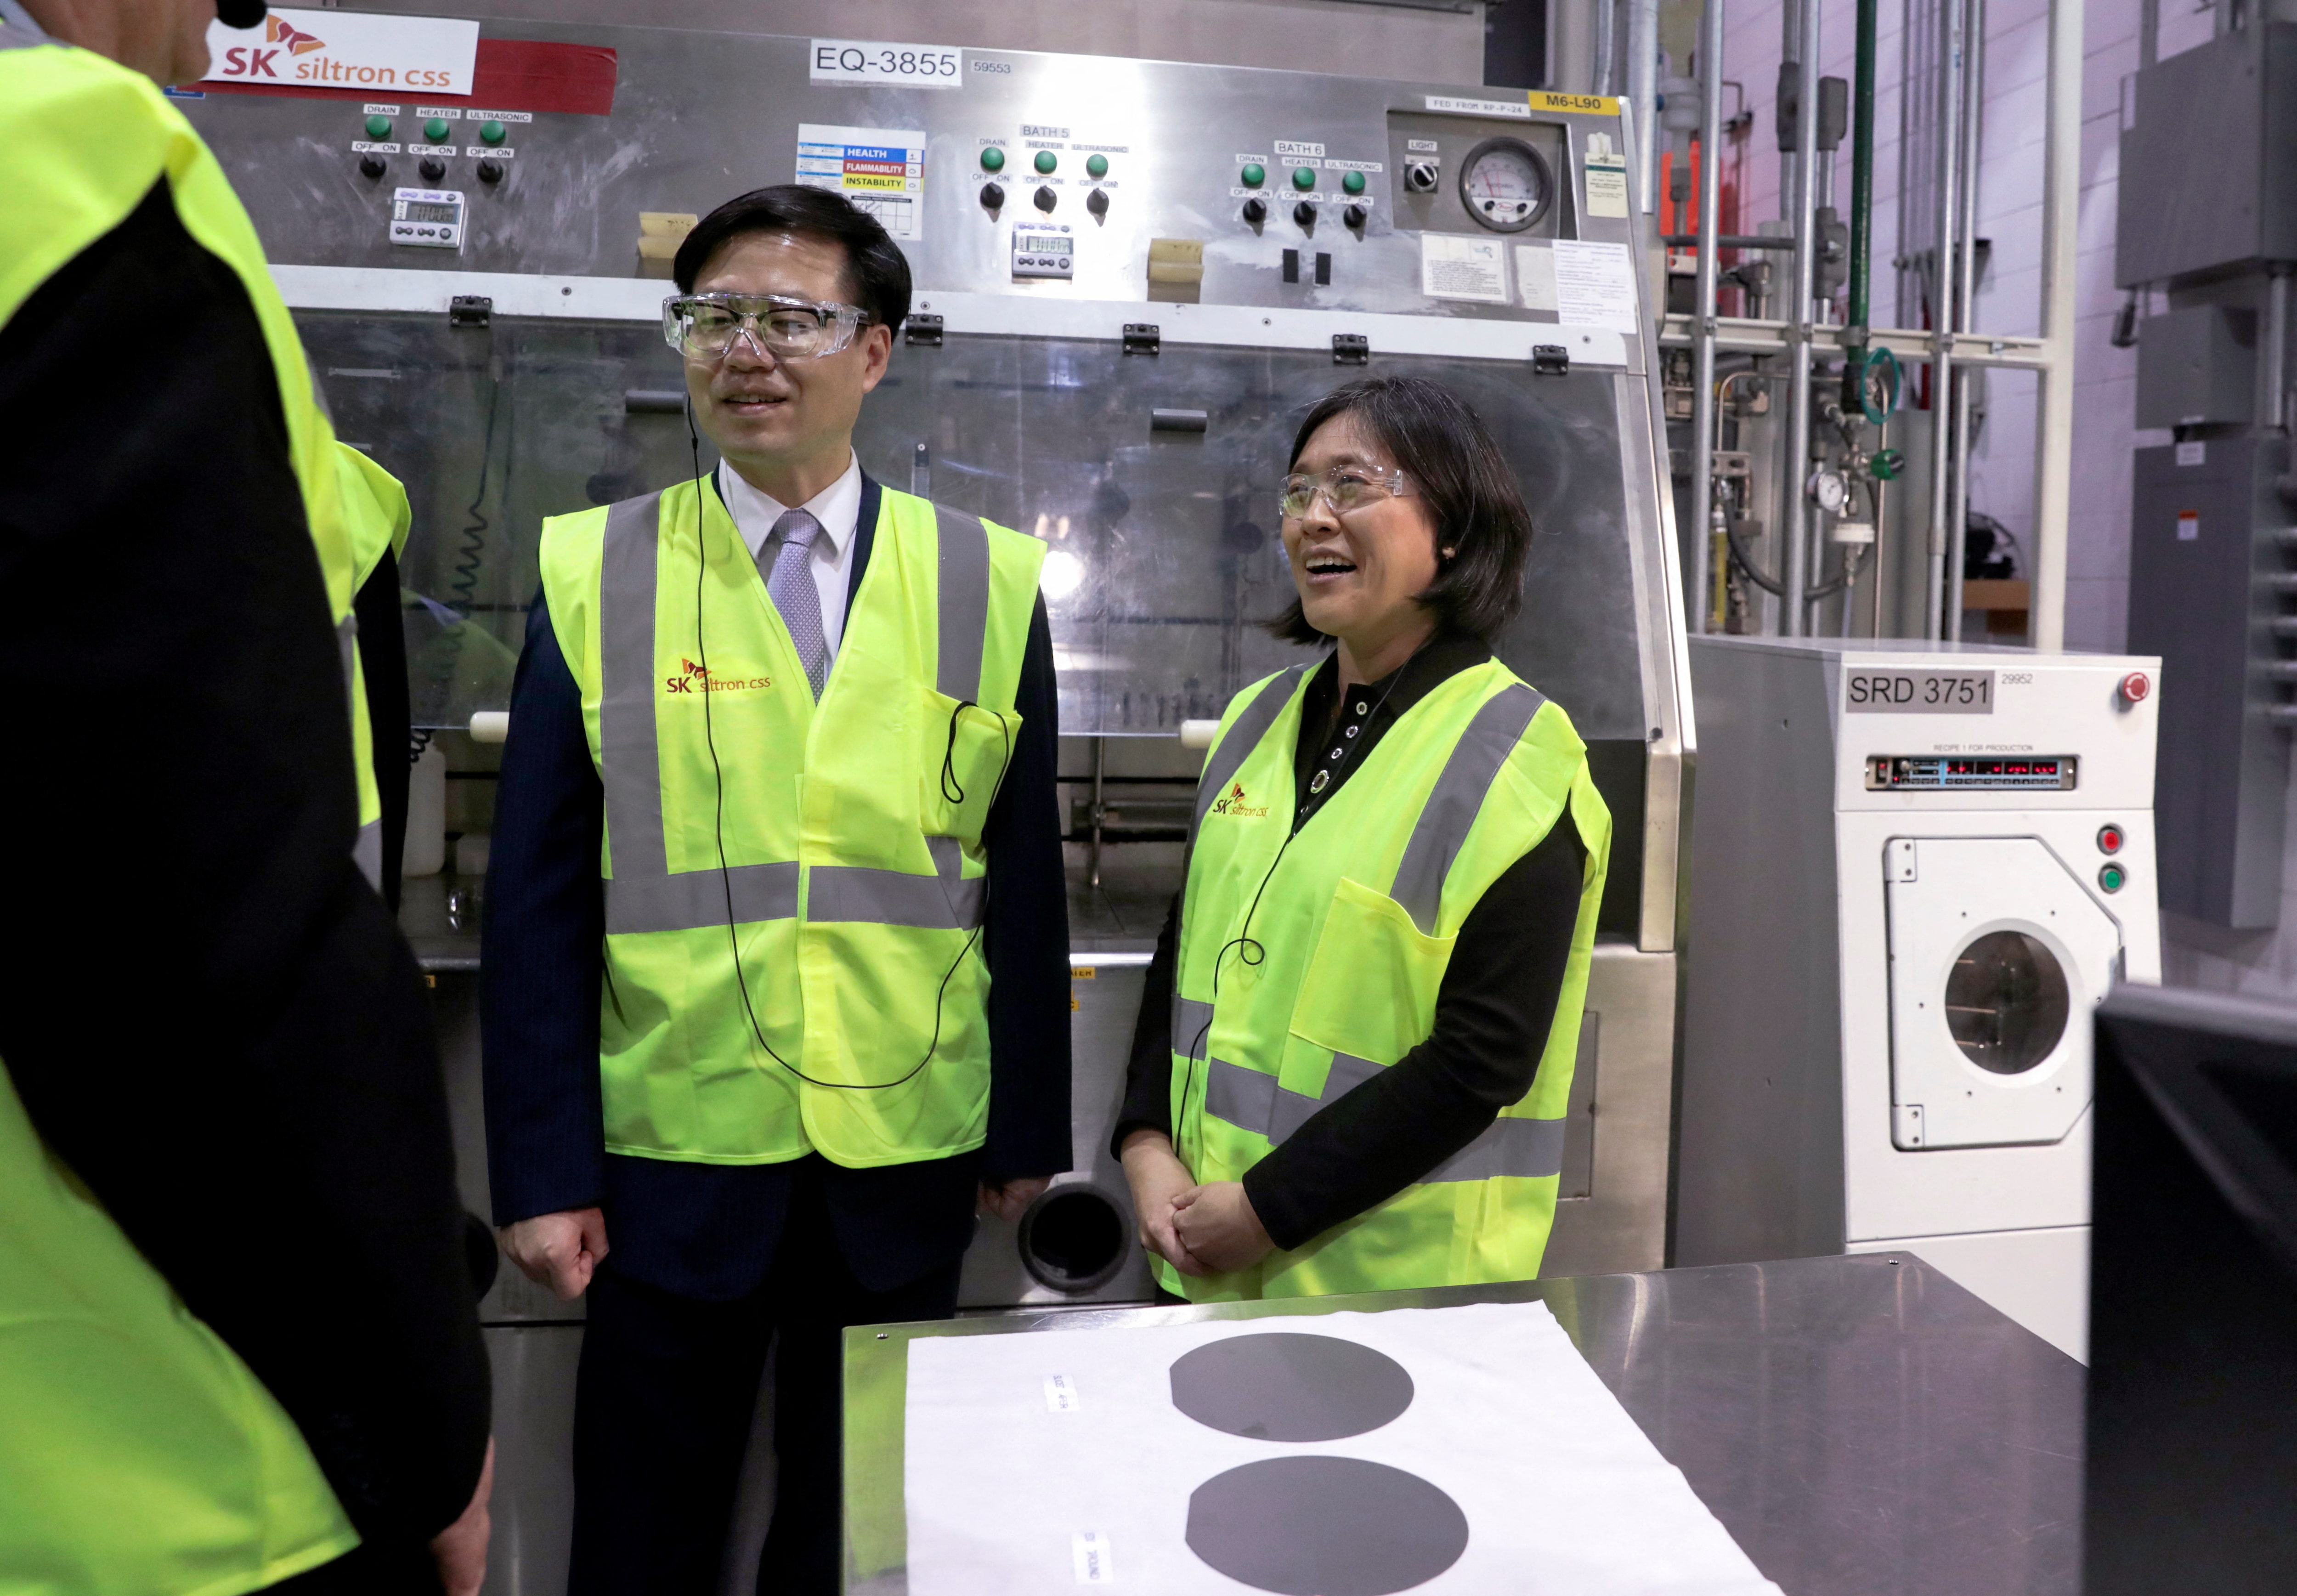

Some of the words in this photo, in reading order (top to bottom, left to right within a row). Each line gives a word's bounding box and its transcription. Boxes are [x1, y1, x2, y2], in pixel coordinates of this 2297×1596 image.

[222, 47, 280, 77] SK
[296, 57, 395, 85] siltron
[405, 69, 451, 86] css
[816, 47, 956, 76] EQ-3855
[974, 61, 1011, 74] 59553
[1456, 102, 1478, 110] FROM
[1546, 94, 1601, 109] M6-L90
[368, 105, 396, 114] DRAIN
[420, 109, 457, 118] HEATER
[470, 112, 529, 121] ULTRASONIC
[1023, 125, 1057, 137] BATH
[1061, 129, 1069, 138] 5
[847, 148, 887, 158] HEALTH
[1073, 144, 1127, 153] ULTRASONIC
[1279, 143, 1311, 154] BATH
[1314, 145, 1322, 155] 6
[846, 163, 902, 173] FLAMMABILITY
[1328, 161, 1380, 170] ULTRASONIC
[846, 177, 902, 187] INSTABILITY
[667, 677, 692, 693] SK
[749, 677, 771, 689] css
[2001, 673, 2033, 685] 29952
[1850, 677, 1914, 703] SRD
[1924, 678, 1987, 704] 3751
[1213, 799, 1232, 814] SK
[1256, 807, 1269, 817] css
